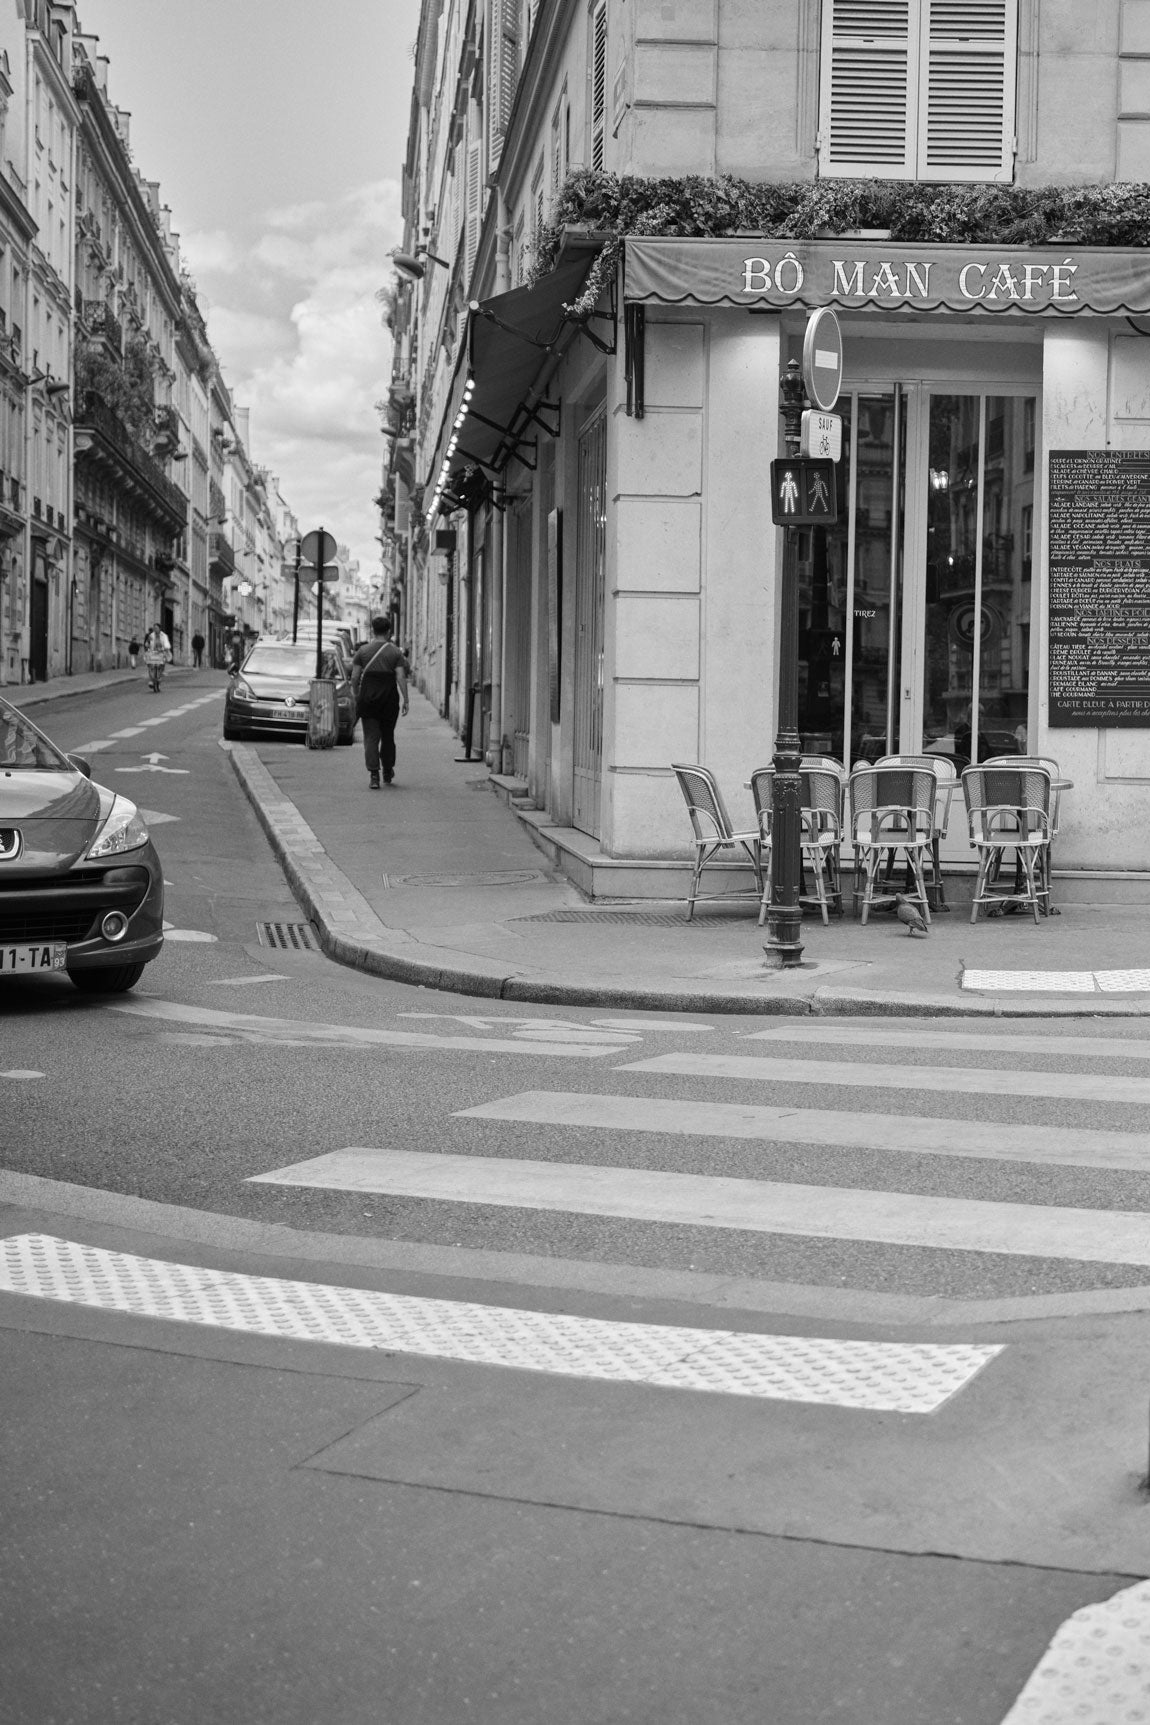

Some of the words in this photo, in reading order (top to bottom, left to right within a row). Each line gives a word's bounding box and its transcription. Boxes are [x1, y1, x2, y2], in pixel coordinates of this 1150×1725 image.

[741, 251, 805, 295] BÔ
[831, 260, 933, 298] MAN
[957, 255, 1080, 300] CAFÉ
[818, 416, 833, 431] SAUF
[854, 609, 876, 619] TIREZ
[54, 957, 65, 967] 93
